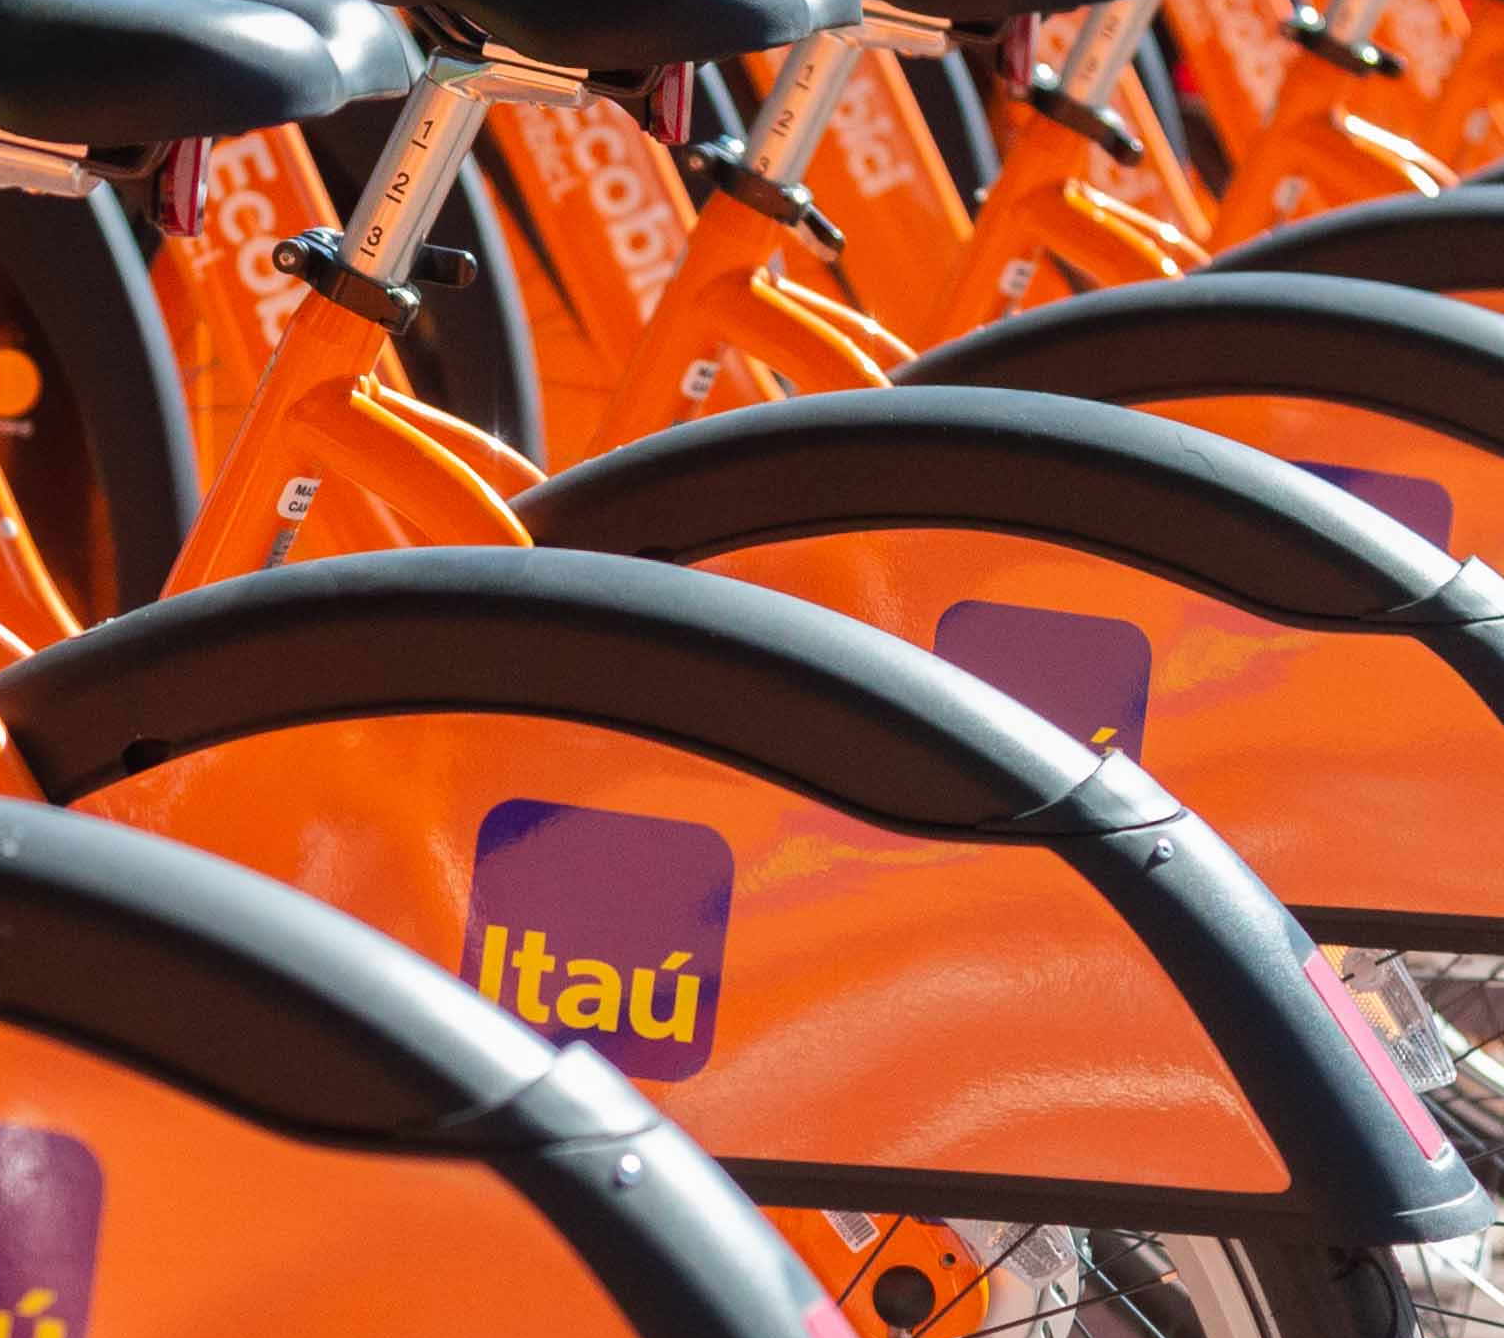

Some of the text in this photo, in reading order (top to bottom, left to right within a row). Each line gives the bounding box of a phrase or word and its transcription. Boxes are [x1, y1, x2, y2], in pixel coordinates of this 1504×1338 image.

[423, 120, 435, 140] 1
[391, 172, 410, 195] 2
[366, 225, 384, 247] 3
[478, 924, 701, 1043] Itaú
